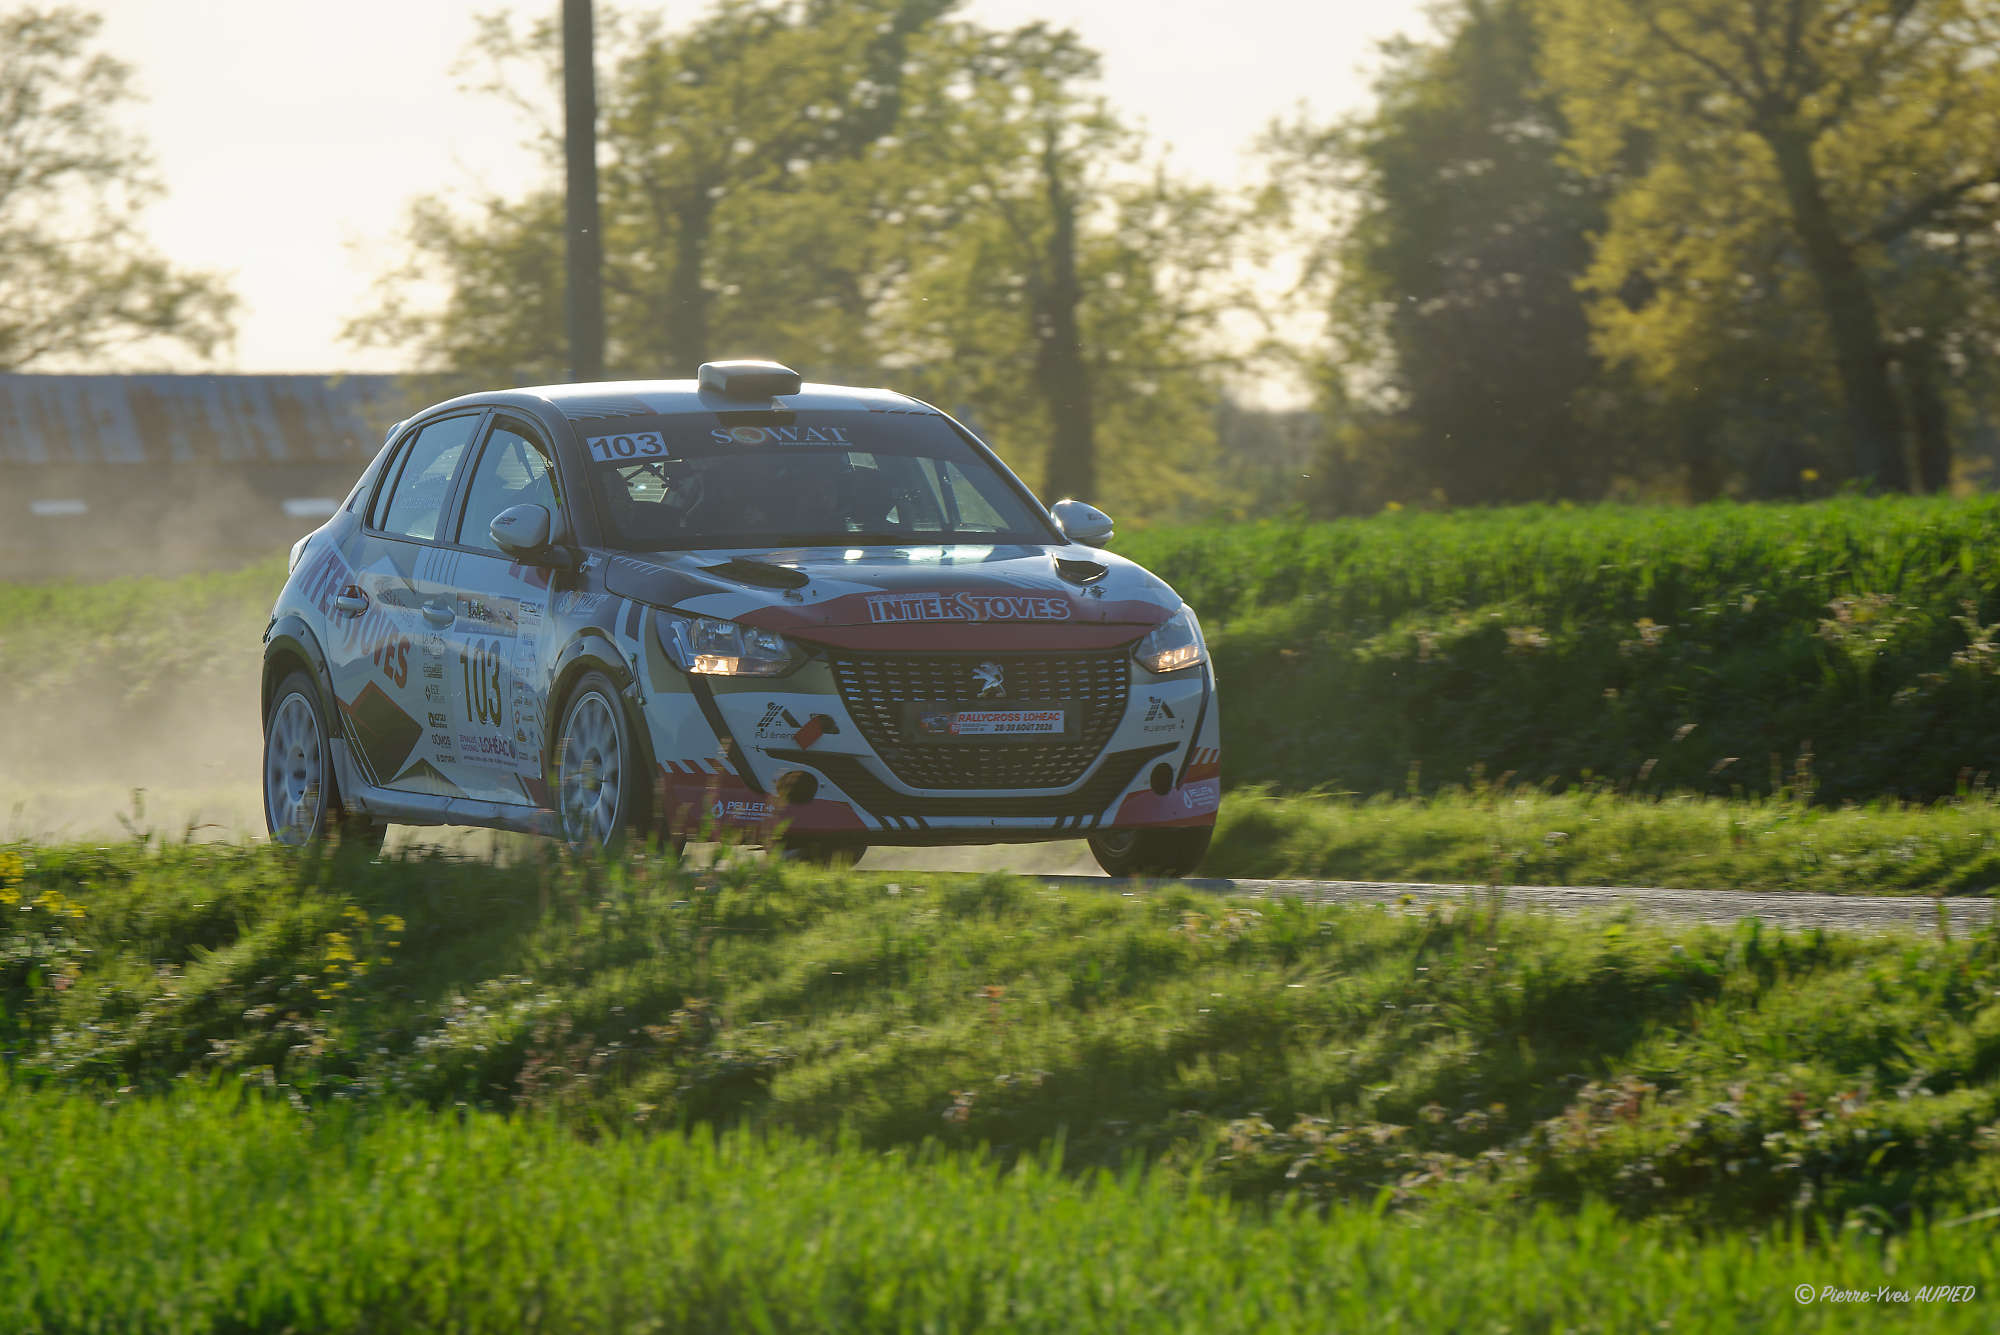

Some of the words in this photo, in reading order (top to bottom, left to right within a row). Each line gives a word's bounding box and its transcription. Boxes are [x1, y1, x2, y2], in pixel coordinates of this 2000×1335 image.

[593, 434, 662, 459] 103
[711, 427, 848, 444] SOWAT
[867, 592, 1071, 624] INTERSTOVES
[460, 637, 502, 728] 103
[958, 713, 1020, 723] RALLYCROSS
